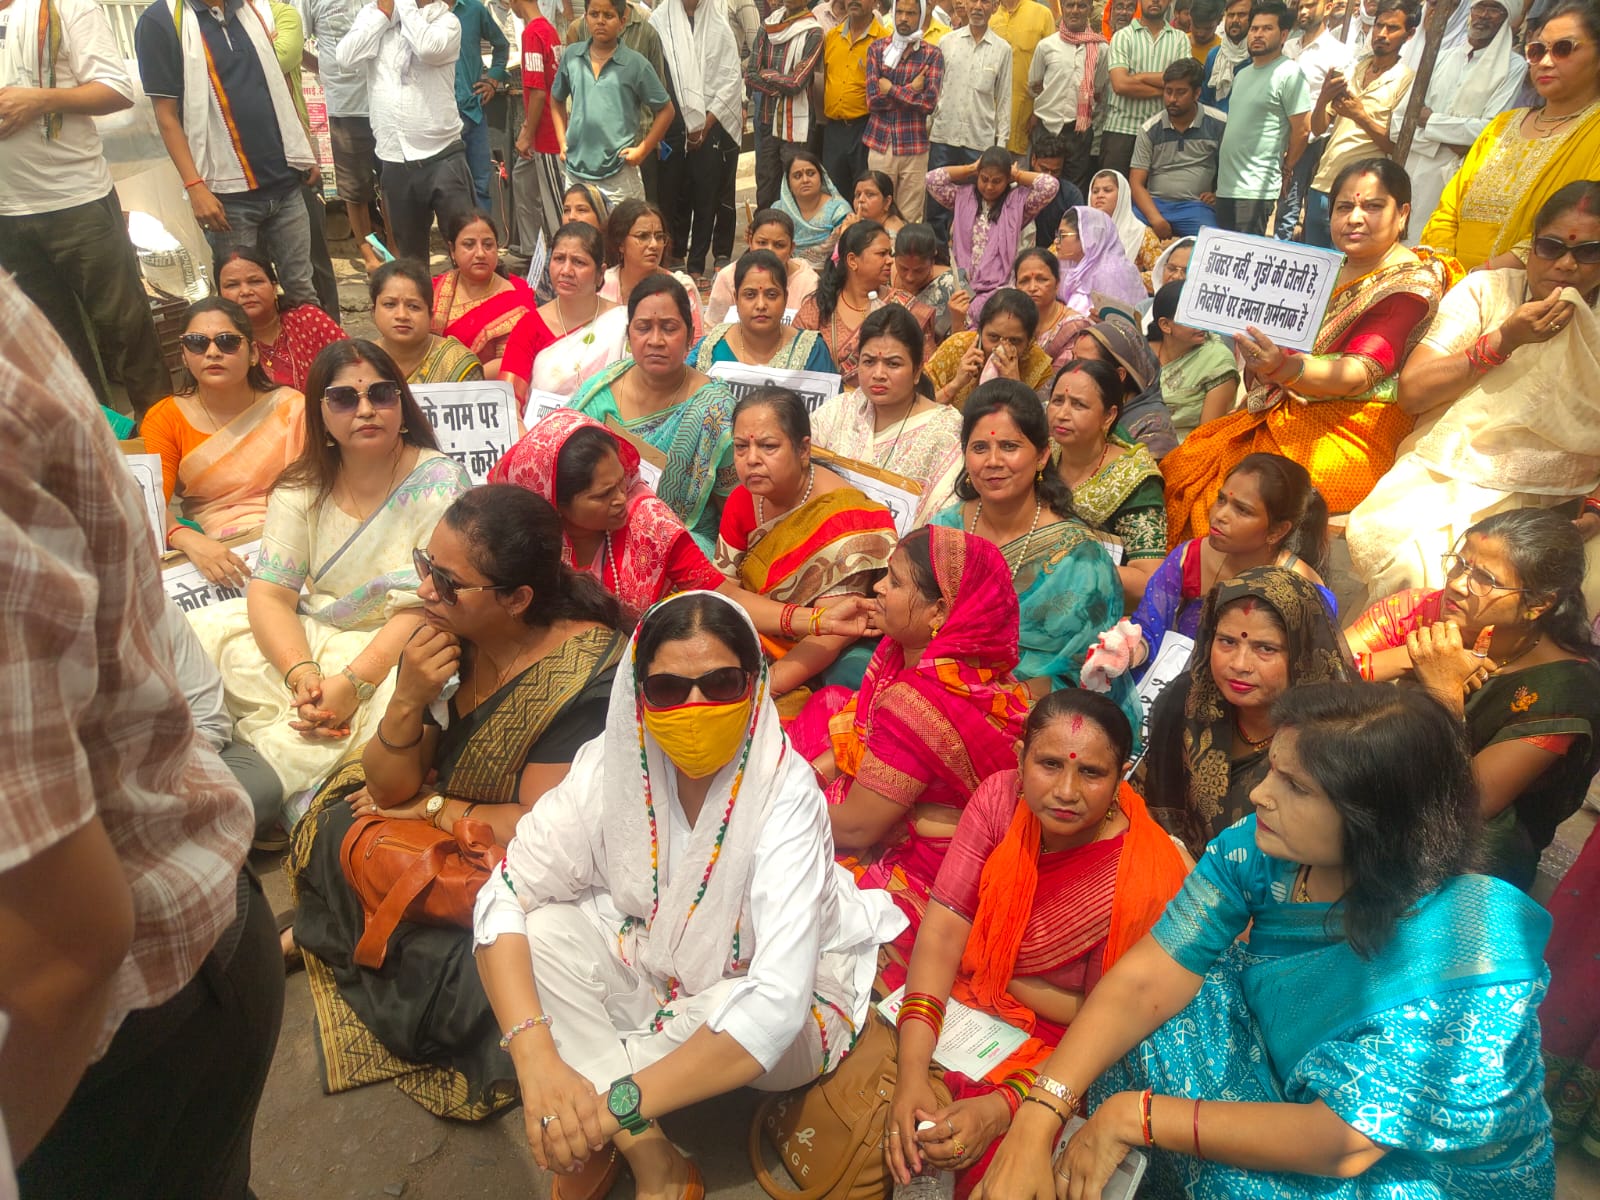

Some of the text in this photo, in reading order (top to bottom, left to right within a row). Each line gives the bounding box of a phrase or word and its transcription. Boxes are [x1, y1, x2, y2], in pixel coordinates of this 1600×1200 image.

[1205, 245, 1318, 300] डॉक्टर नहीं, गुंडों की टोली है,
[1195, 283, 1308, 331] निर्दोषों पर हमला शर्मनाक है
[441, 404, 473, 430] नाम
[477, 402, 499, 428] पर
